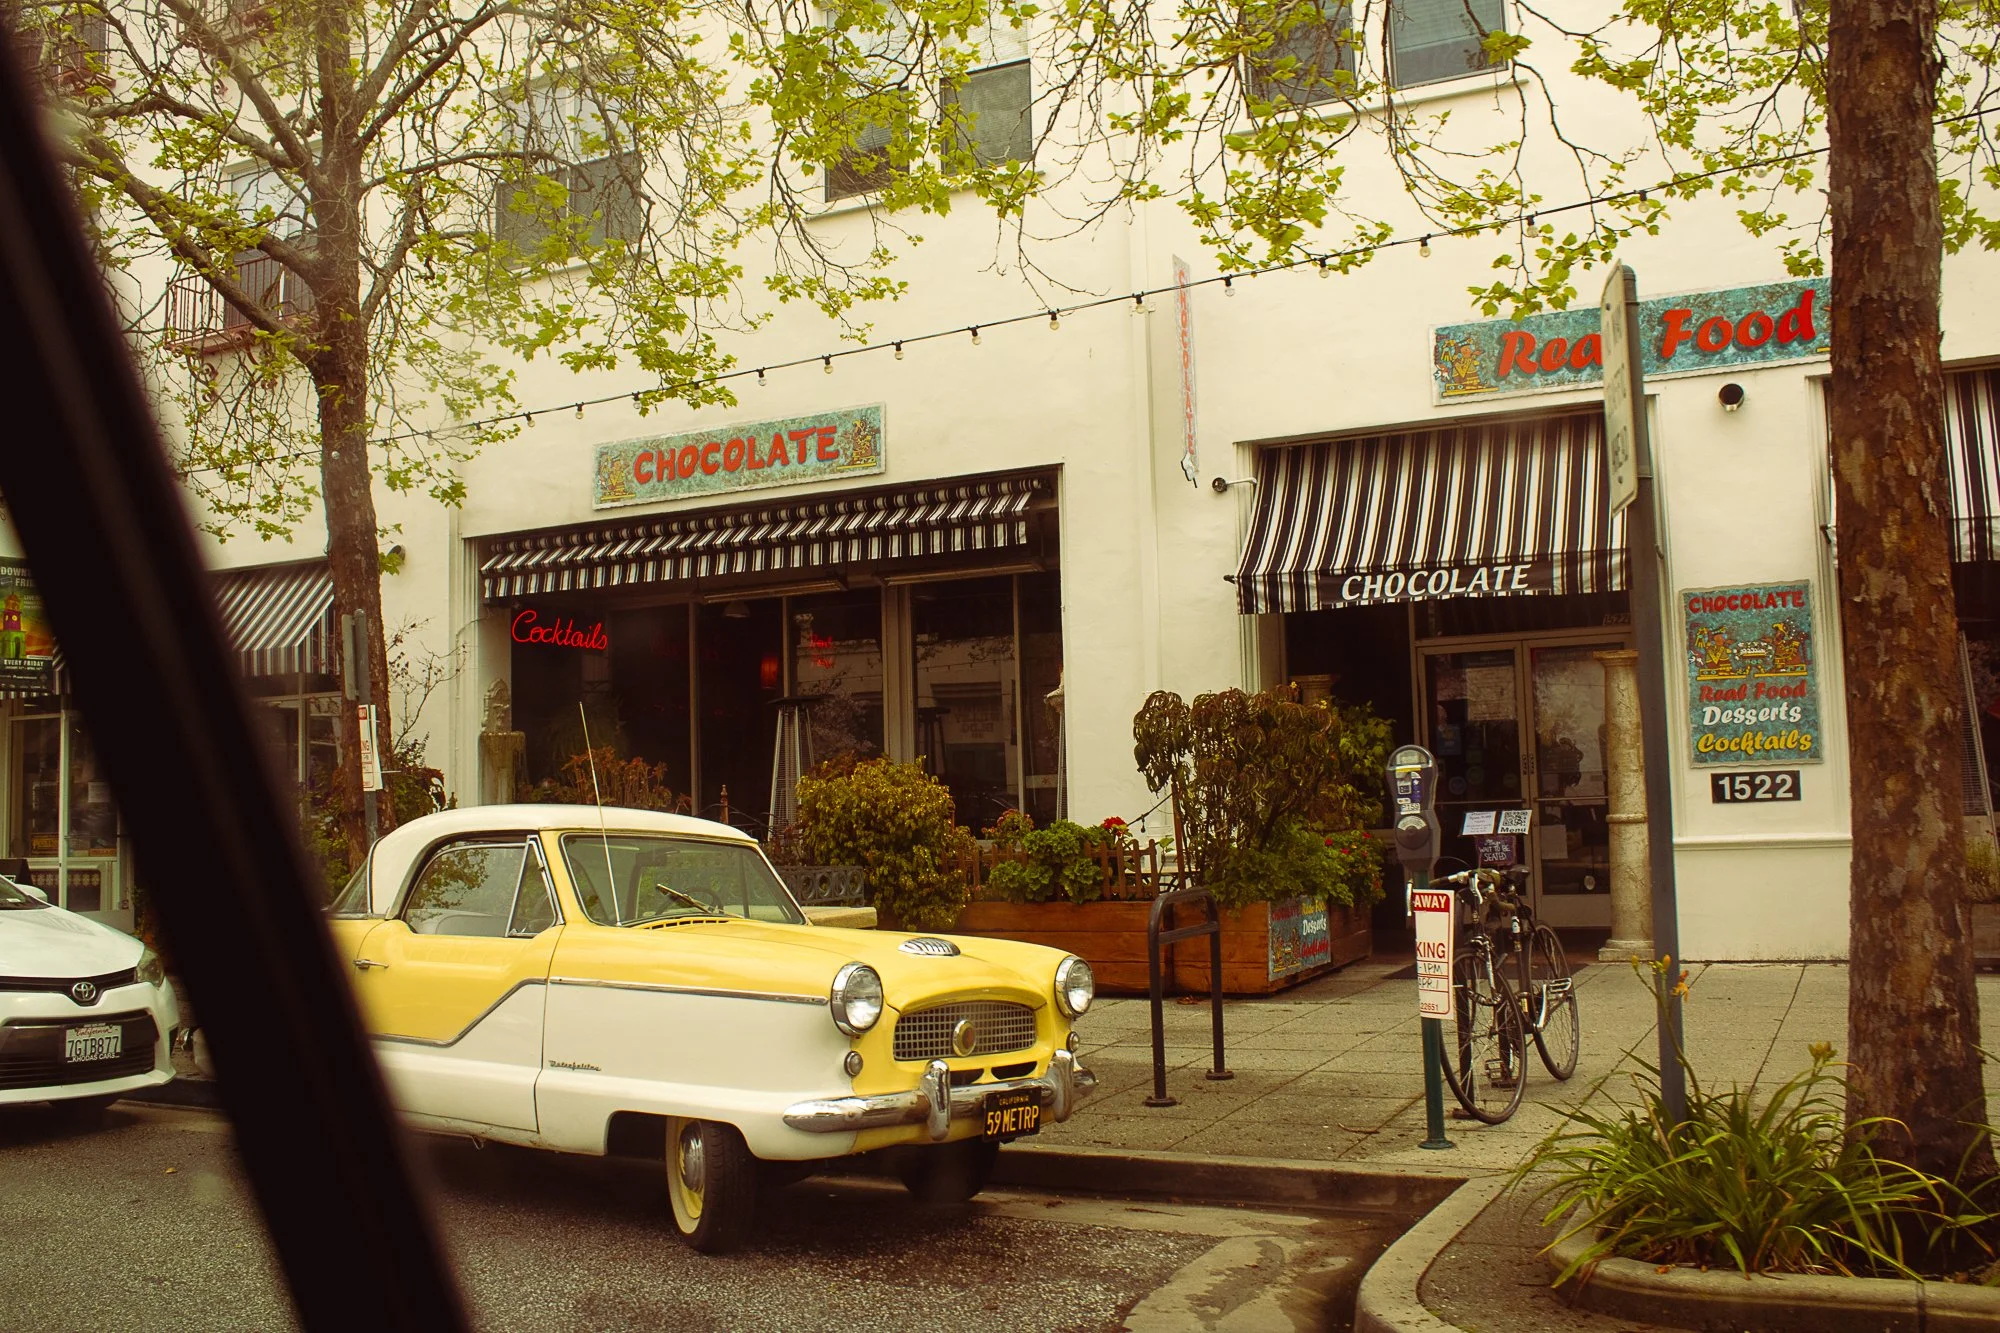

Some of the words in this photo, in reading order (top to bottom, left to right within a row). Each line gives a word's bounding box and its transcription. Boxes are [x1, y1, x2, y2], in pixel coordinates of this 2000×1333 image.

[1497, 330, 1603, 378] Rea
[1660, 289, 1817, 359] Food
[632, 425, 840, 485] CHOCOLATE
[1341, 563, 1532, 601] CHOCOLATE
[1688, 590, 1806, 614] CHOCOLATE
[511, 609, 608, 651] Cocktails
[1699, 683, 1747, 702] Real
[1754, 679, 1807, 700] Food
[1702, 701, 1802, 726] Desserts
[1696, 729, 1812, 755] Cocktails
[1717, 773, 1794, 801] 1522
[1500, 826, 1526, 834] Menu
[1483, 852, 1507, 862] SEATED
[1502, 844, 1511, 852] BE
[1414, 894, 1447, 909] AWAY
[1303, 914, 1327, 935] Desserts
[76, 1027, 112, 1037] California
[68, 1036, 119, 1056] 7GTB877
[999, 1095, 1030, 1106] CALIFORNIA
[986, 1105, 1039, 1136] 59METRP
